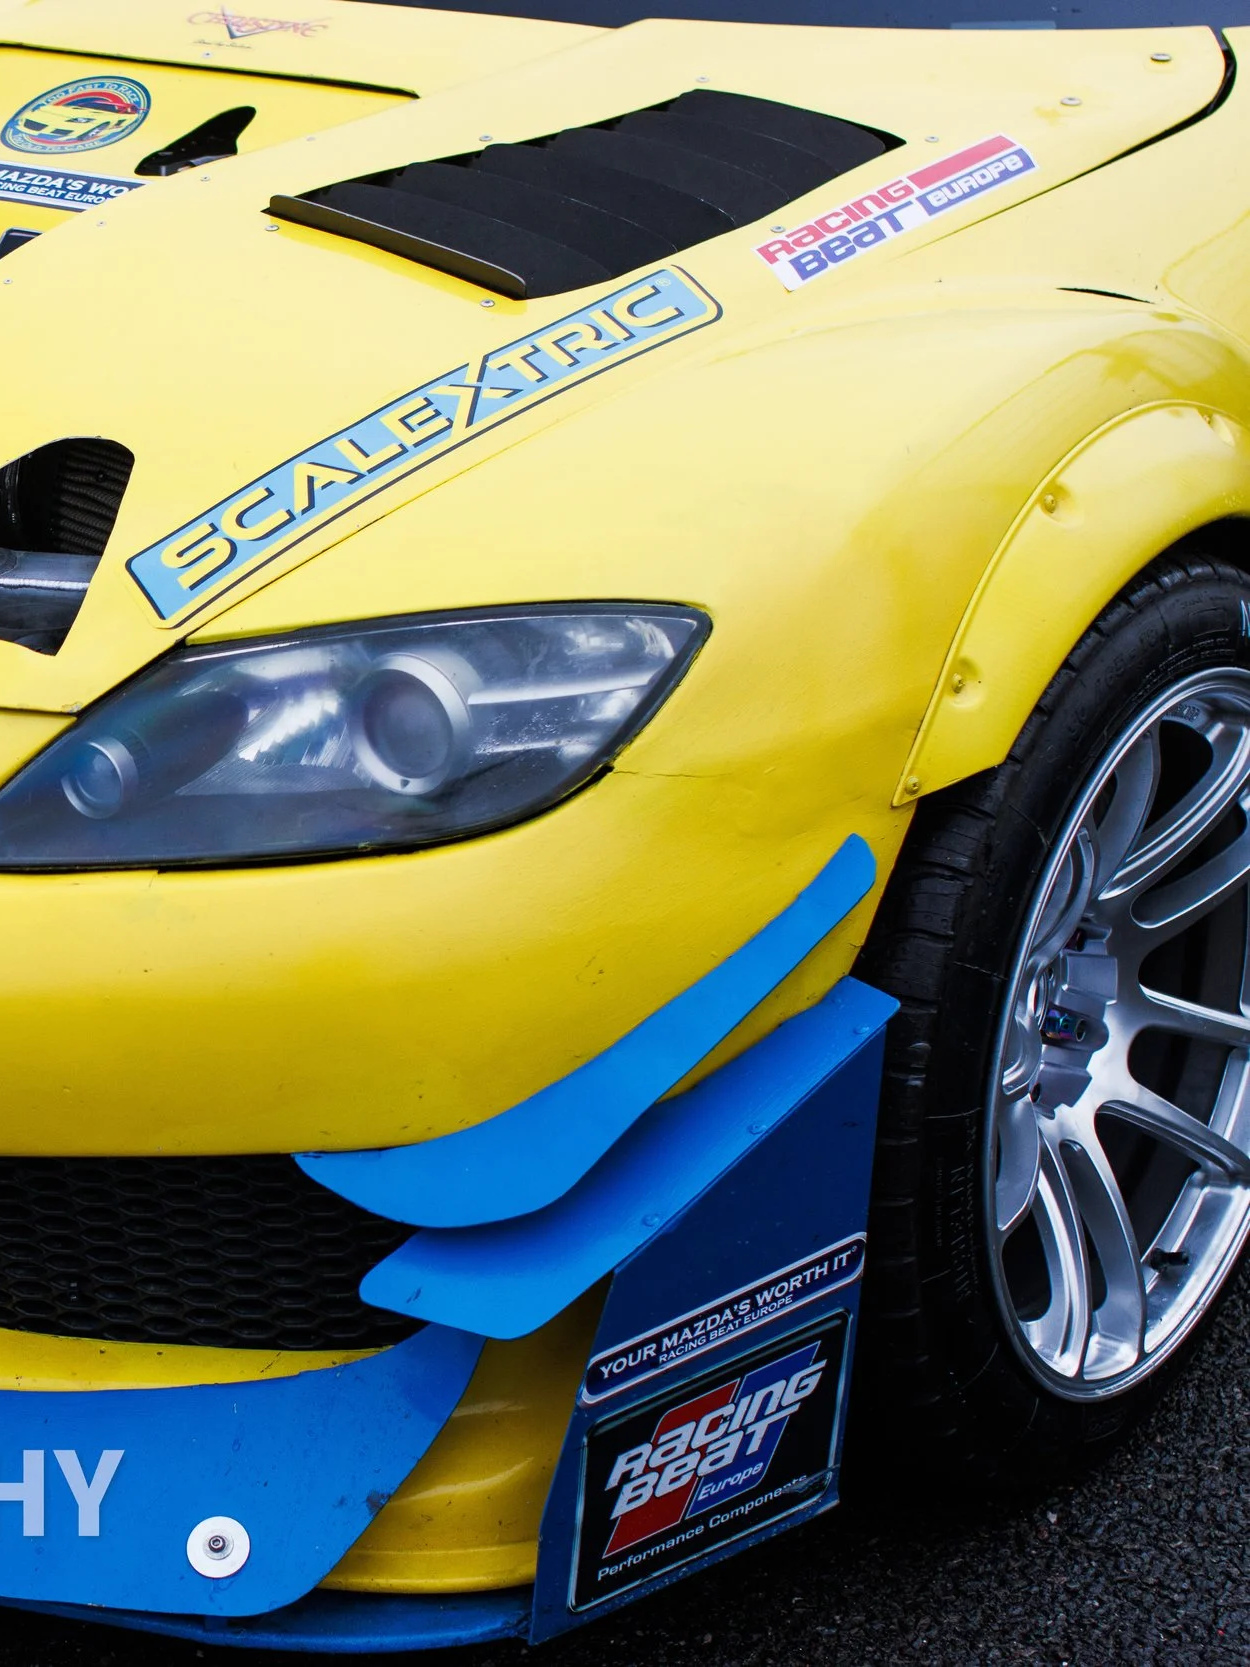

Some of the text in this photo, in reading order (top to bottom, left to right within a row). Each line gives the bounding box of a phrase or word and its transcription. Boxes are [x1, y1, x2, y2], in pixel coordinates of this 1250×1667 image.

[26, 185, 67, 199] BEAT
[160, 284, 687, 592] SCALEXTRIC
[599, 1250, 852, 1379] YOUR MAZDA'S WORTH IT
[658, 1294, 793, 1363] RACING BEAT EUROPE
[697, 1462, 764, 1501] Europe
[596, 1475, 808, 1582] Performance Components
